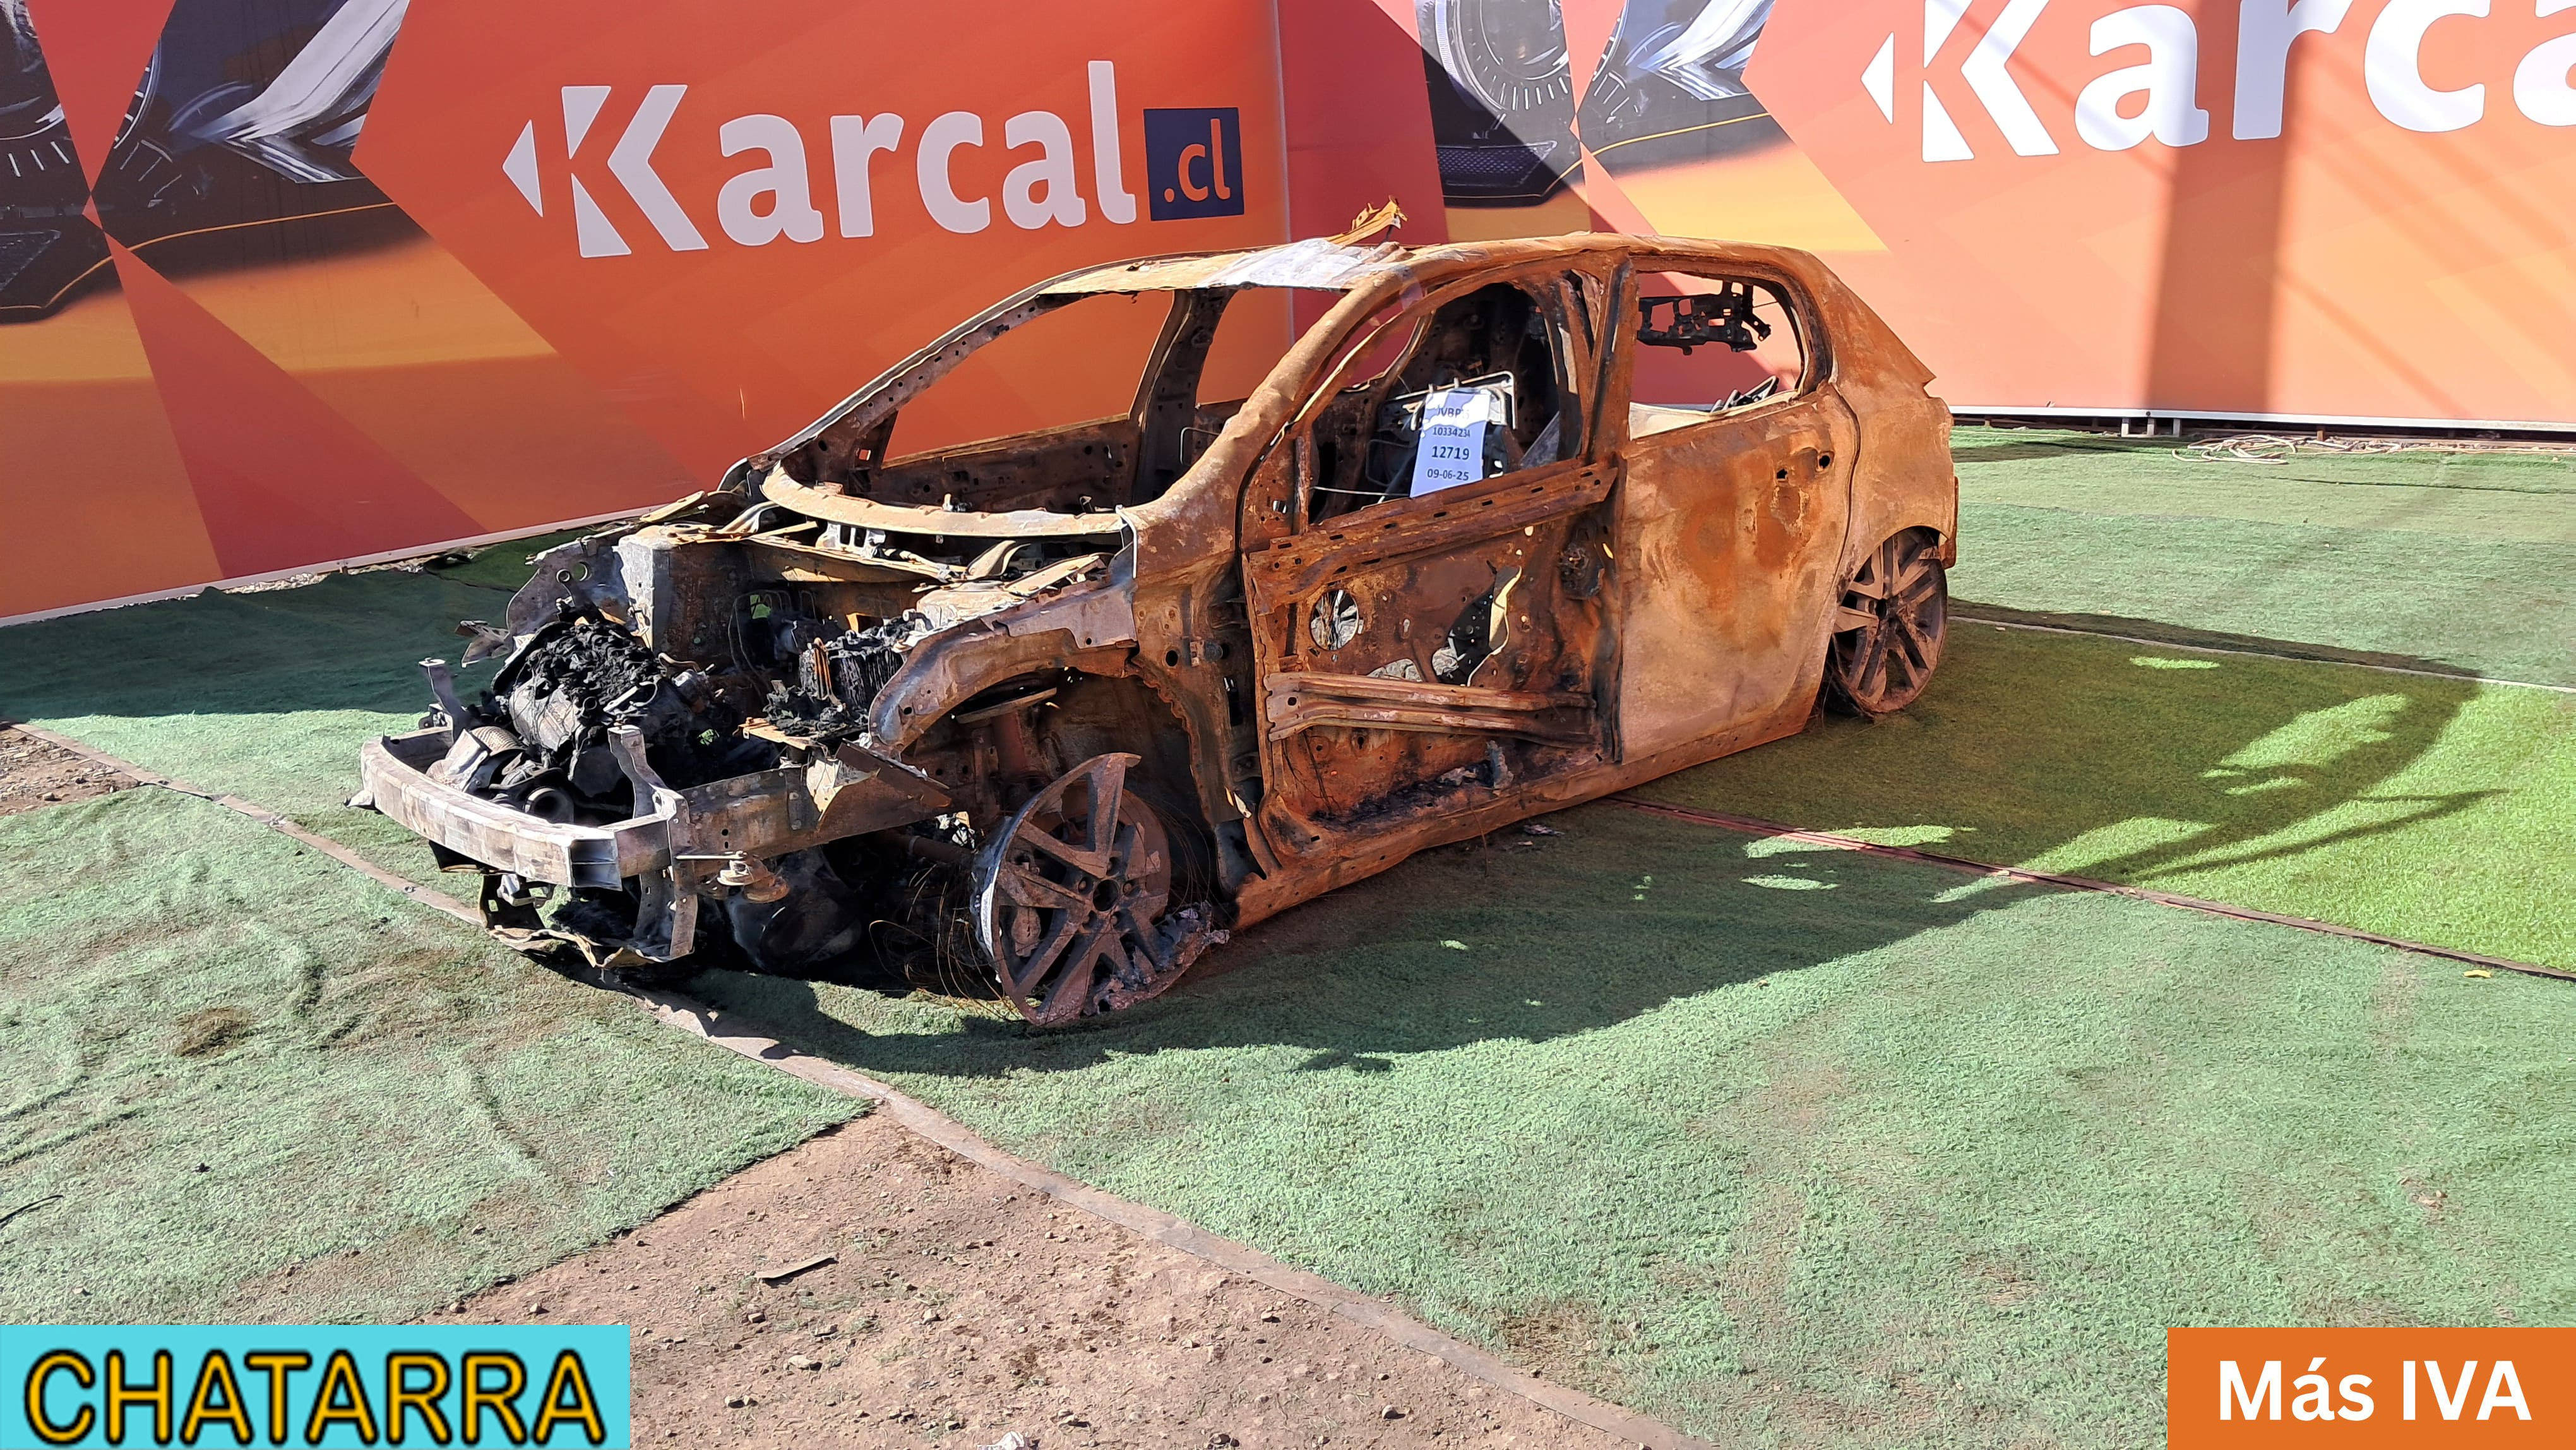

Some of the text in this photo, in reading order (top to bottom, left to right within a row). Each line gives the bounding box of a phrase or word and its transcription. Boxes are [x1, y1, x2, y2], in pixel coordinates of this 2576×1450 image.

[560, 59, 1231, 258] Karcal .cl
[1431, 445, 1470, 460] 12719
[1427, 469, 1469, 481] 09-06-25
